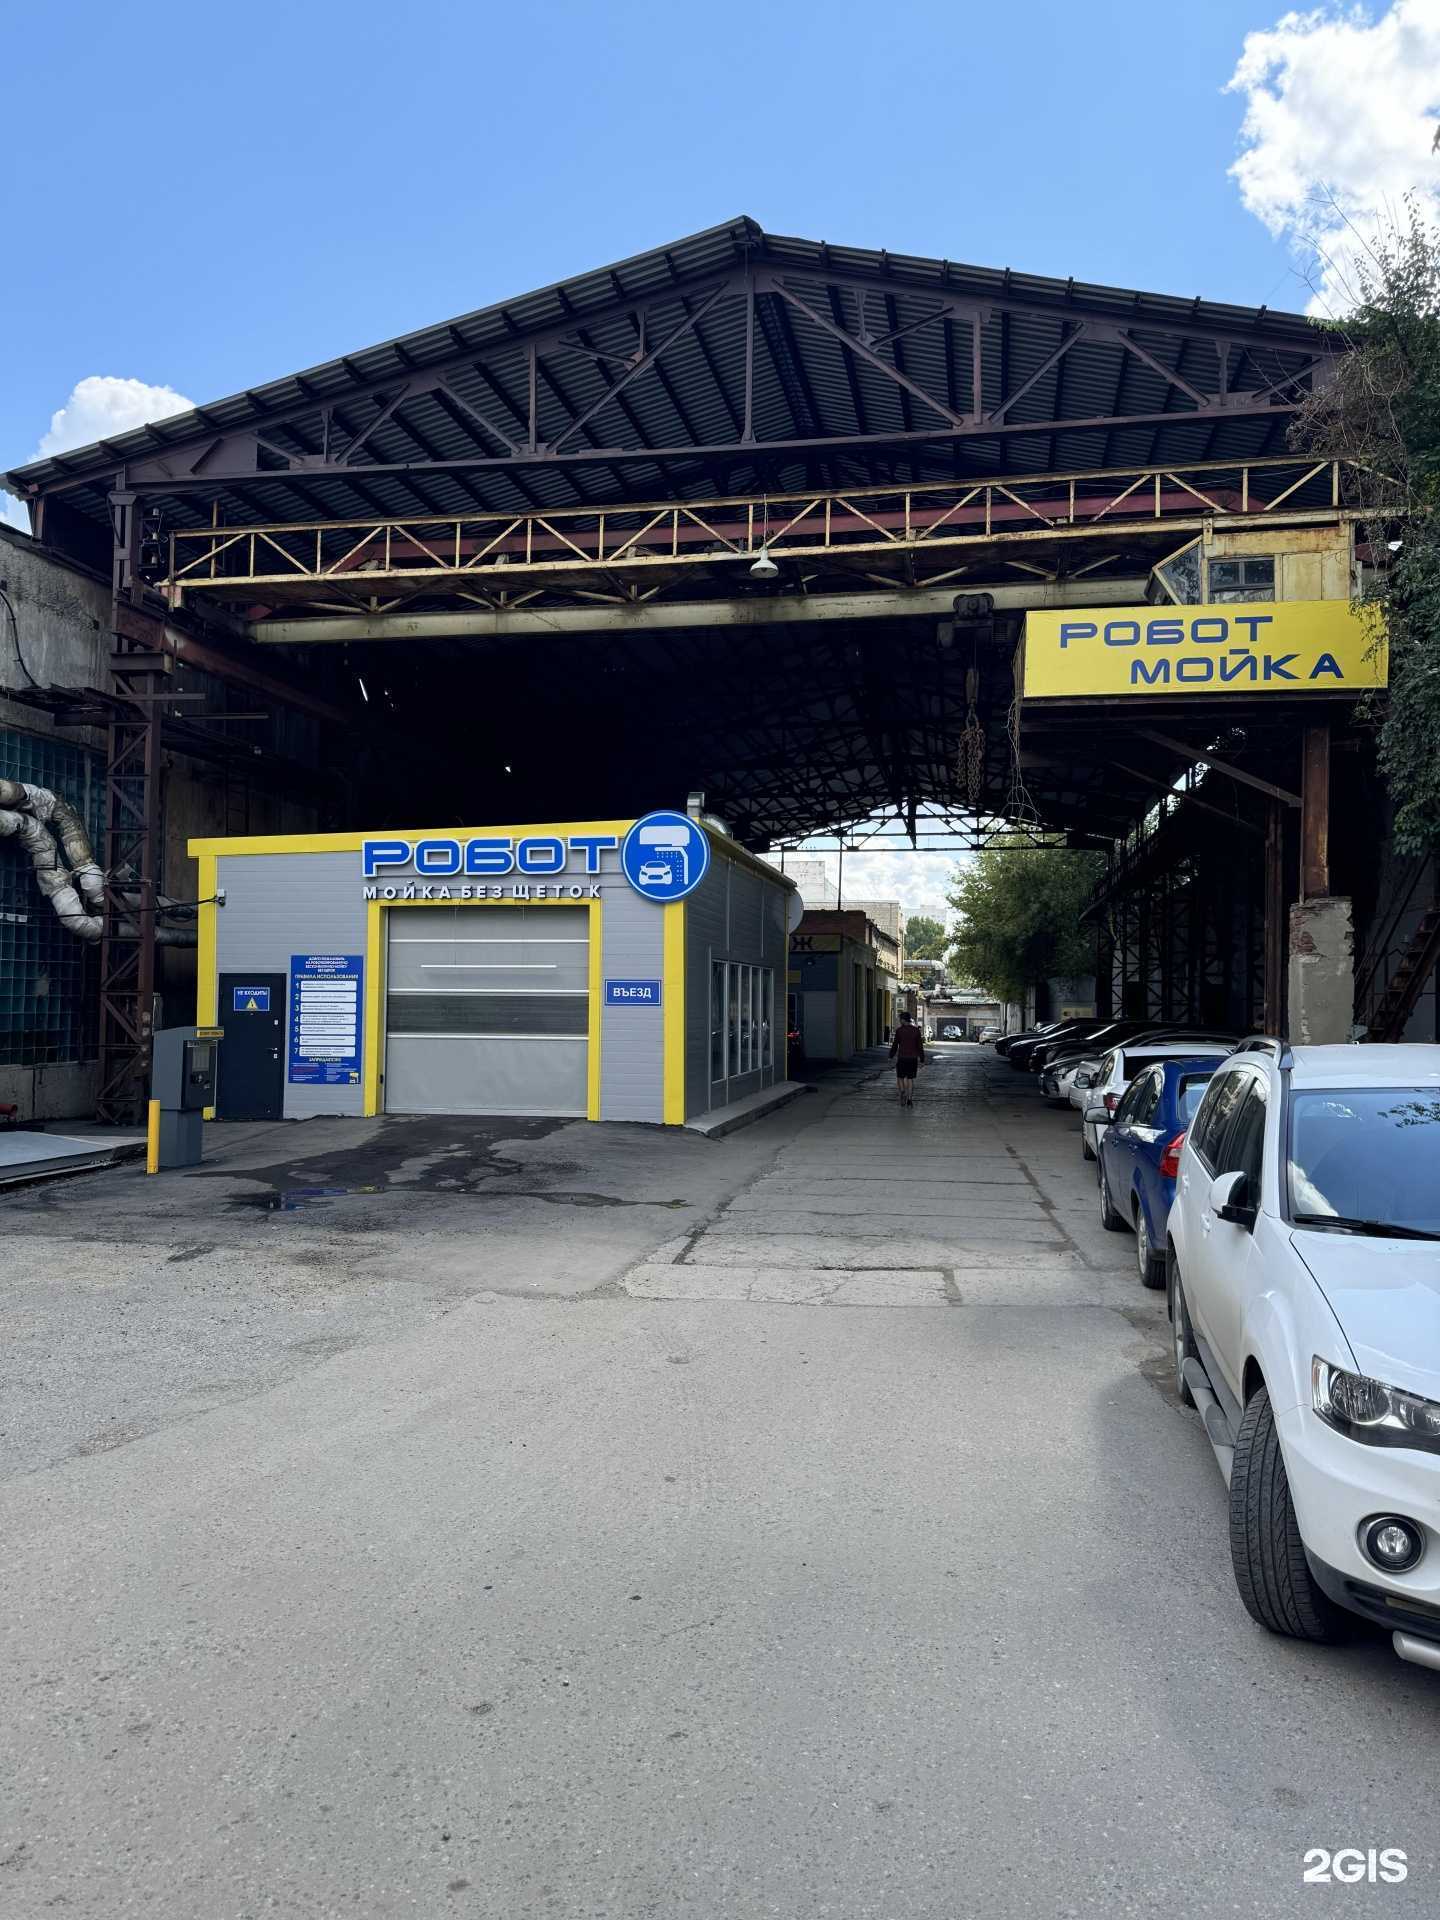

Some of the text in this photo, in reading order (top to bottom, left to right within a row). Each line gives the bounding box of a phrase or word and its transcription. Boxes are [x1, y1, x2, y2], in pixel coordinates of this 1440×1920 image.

[1060, 615, 1273, 648] РОБОТ
[1130, 648, 1344, 684] МОЙКА
[362, 836, 618, 877] РОБОТ
[363, 881, 601, 900] МОЙКА БЕЗ ЩЕТОК
[613, 987, 652, 998] ВЪЕЗД
